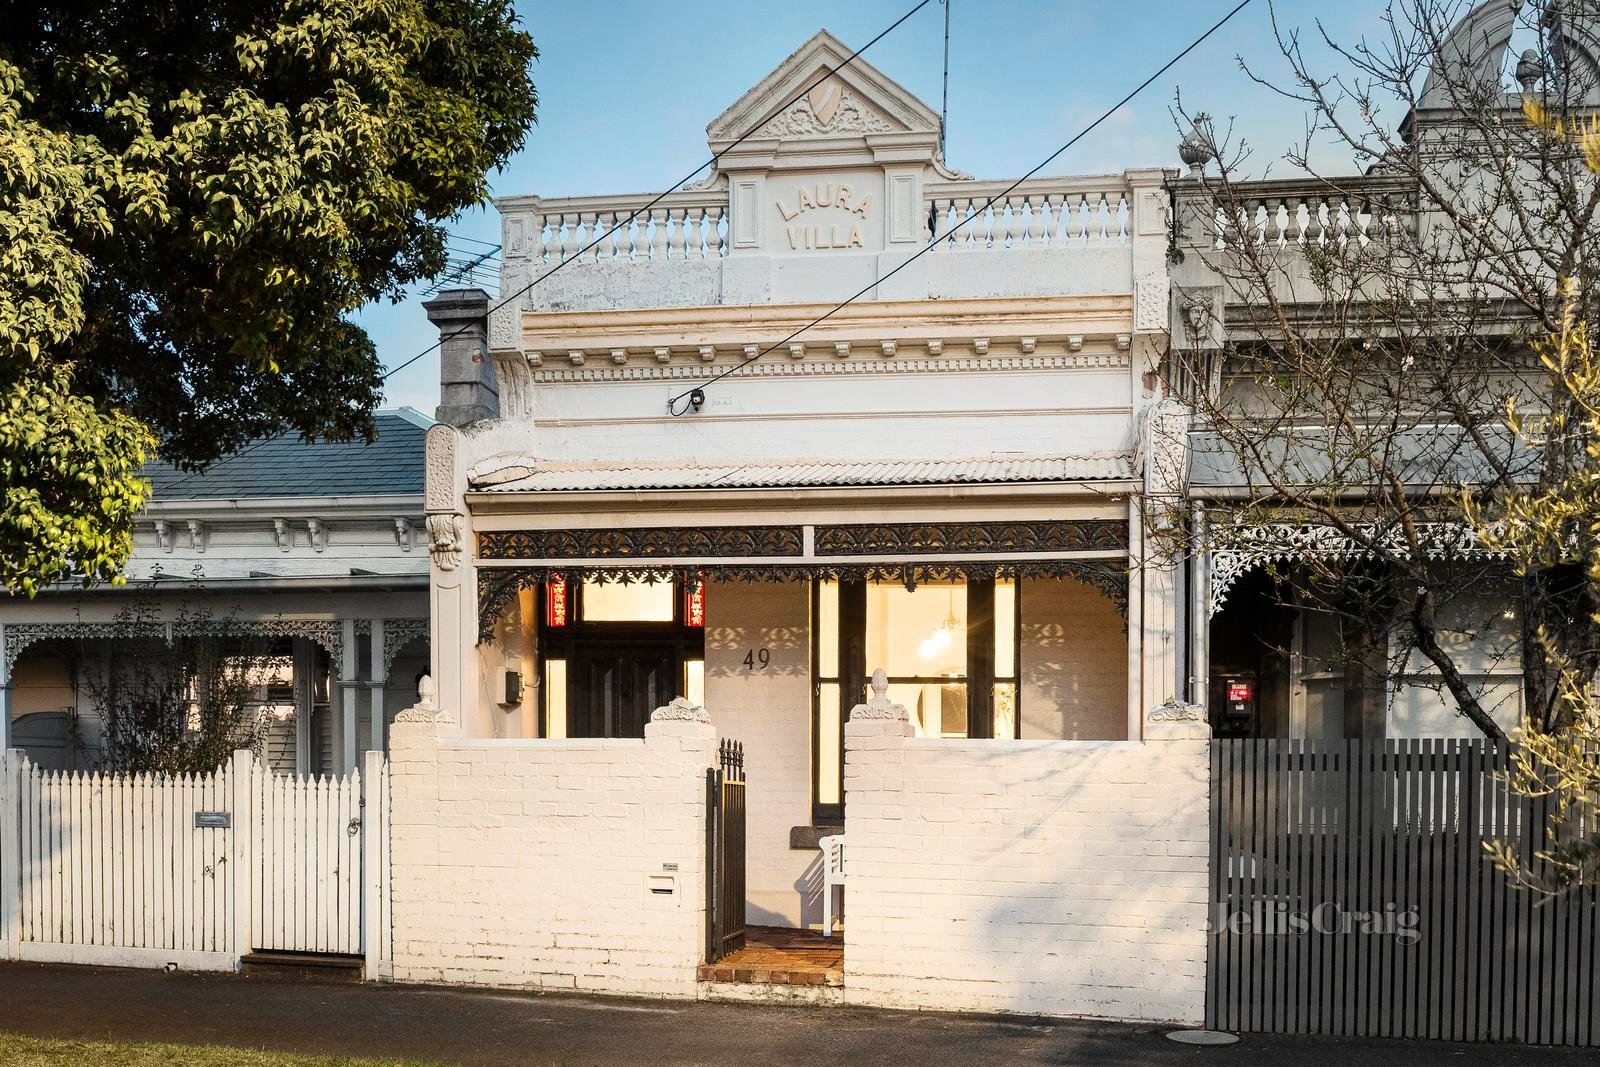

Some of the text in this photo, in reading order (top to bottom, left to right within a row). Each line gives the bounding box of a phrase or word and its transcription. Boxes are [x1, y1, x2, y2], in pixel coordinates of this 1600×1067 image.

[776, 182, 872, 221] LAURA
[786, 224, 863, 249] VILLA
[743, 648, 769, 670] 49
